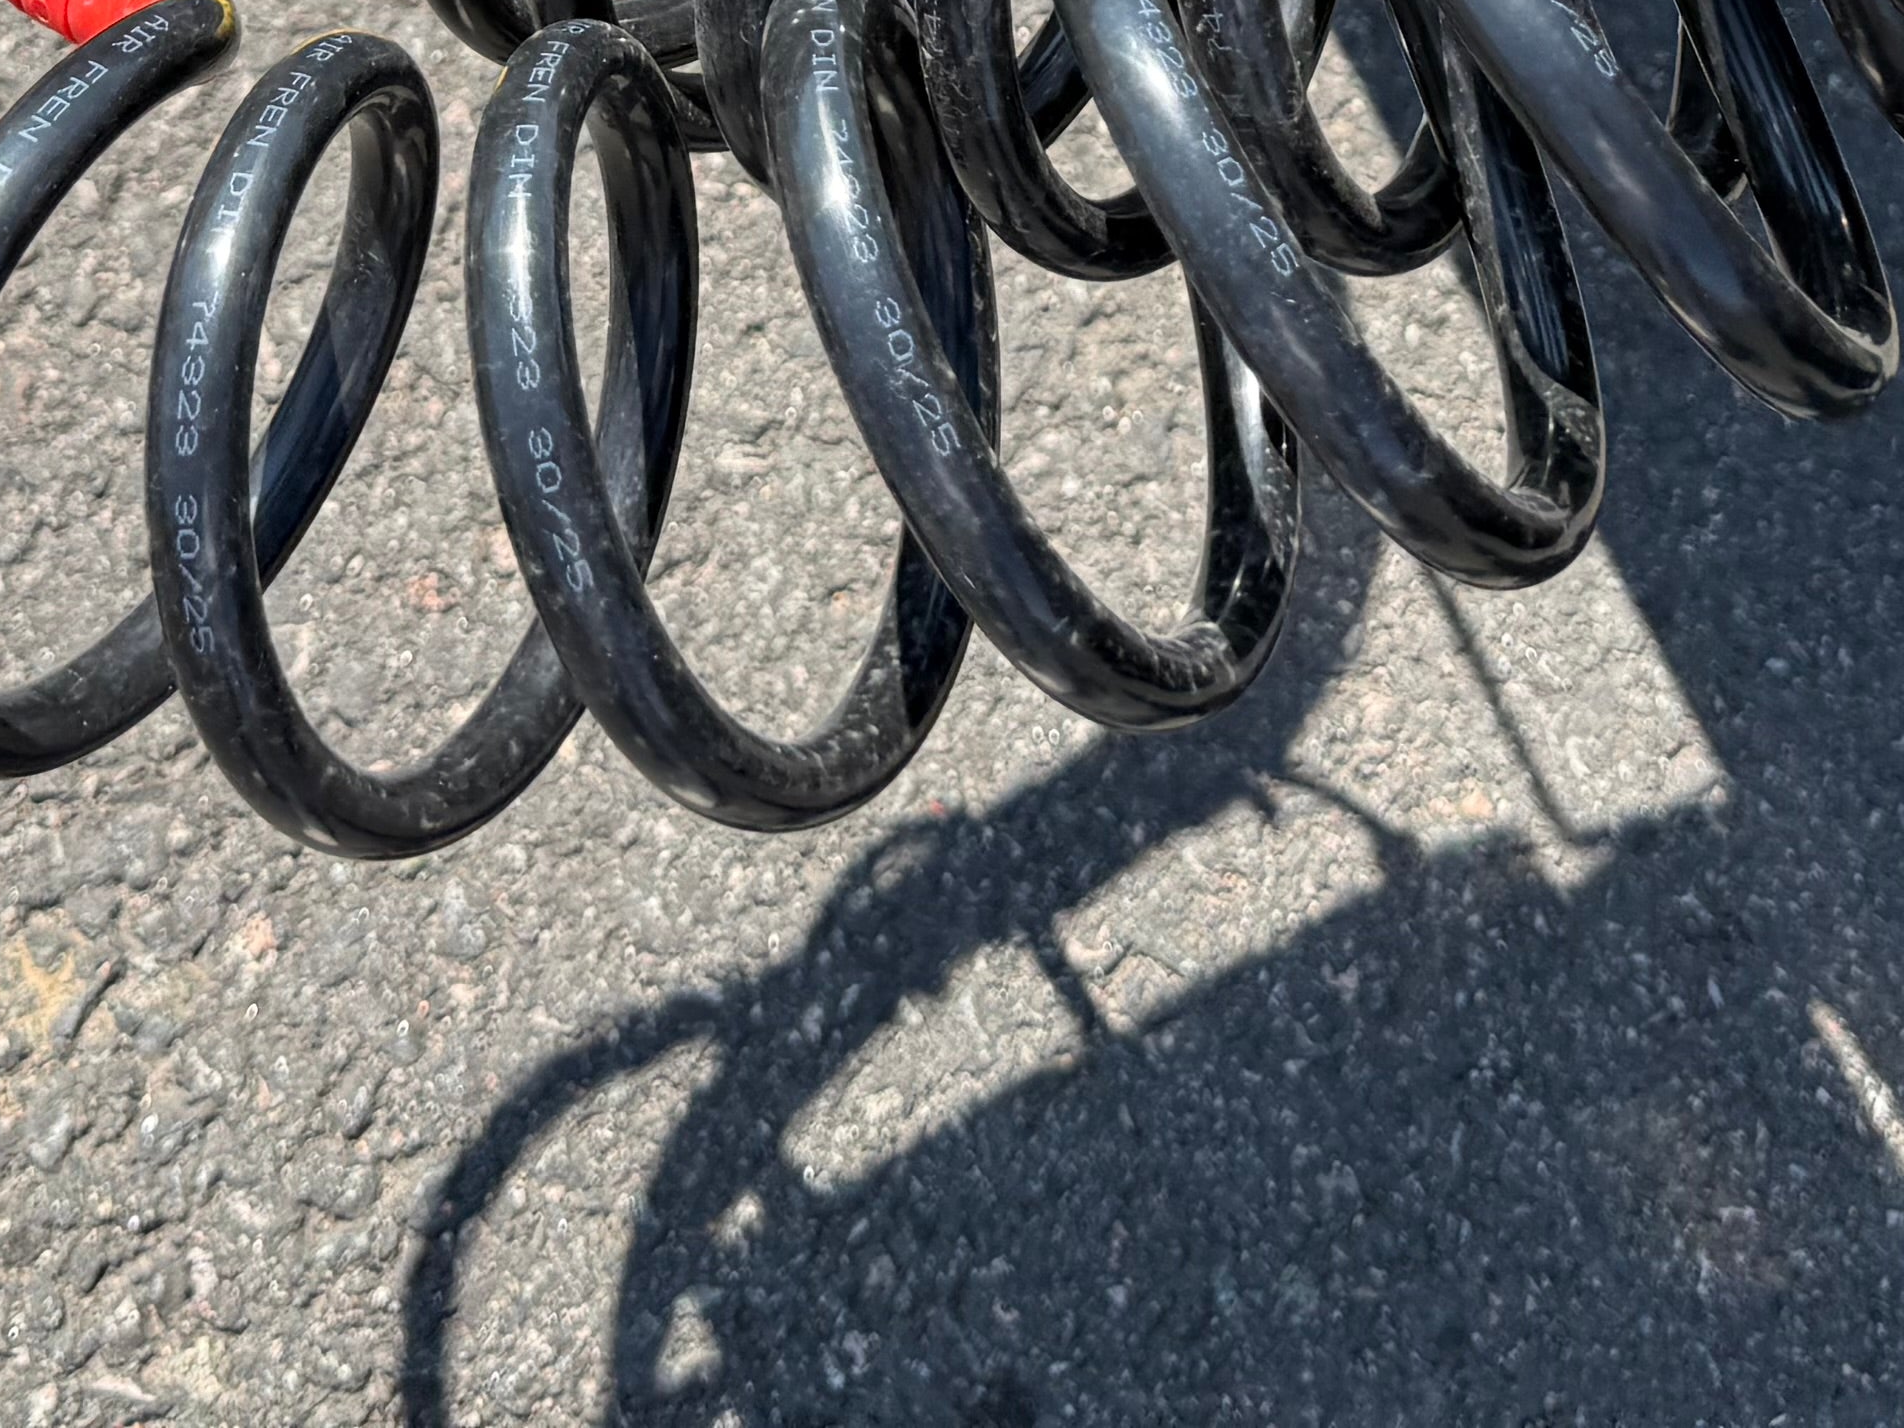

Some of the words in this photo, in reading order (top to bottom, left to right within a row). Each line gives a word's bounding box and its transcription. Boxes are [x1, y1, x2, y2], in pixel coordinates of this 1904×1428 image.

[111, 14, 170, 54] AIR
[305, 33, 354, 63] AIR
[521, 39, 570, 104] FREN
[17, 59, 110, 143] FREN
[246, 70, 314, 148] FREN
[506, 123, 540, 198] DIN
[810, 28, 840, 94] DIN
[875, 297, 962, 457] 30/25
[1201, 128, 1300, 278] 30/25
[174, 291, 220, 458] 74323
[528, 426, 595, 593] 30/25
[174, 494, 217, 655] 30/25
